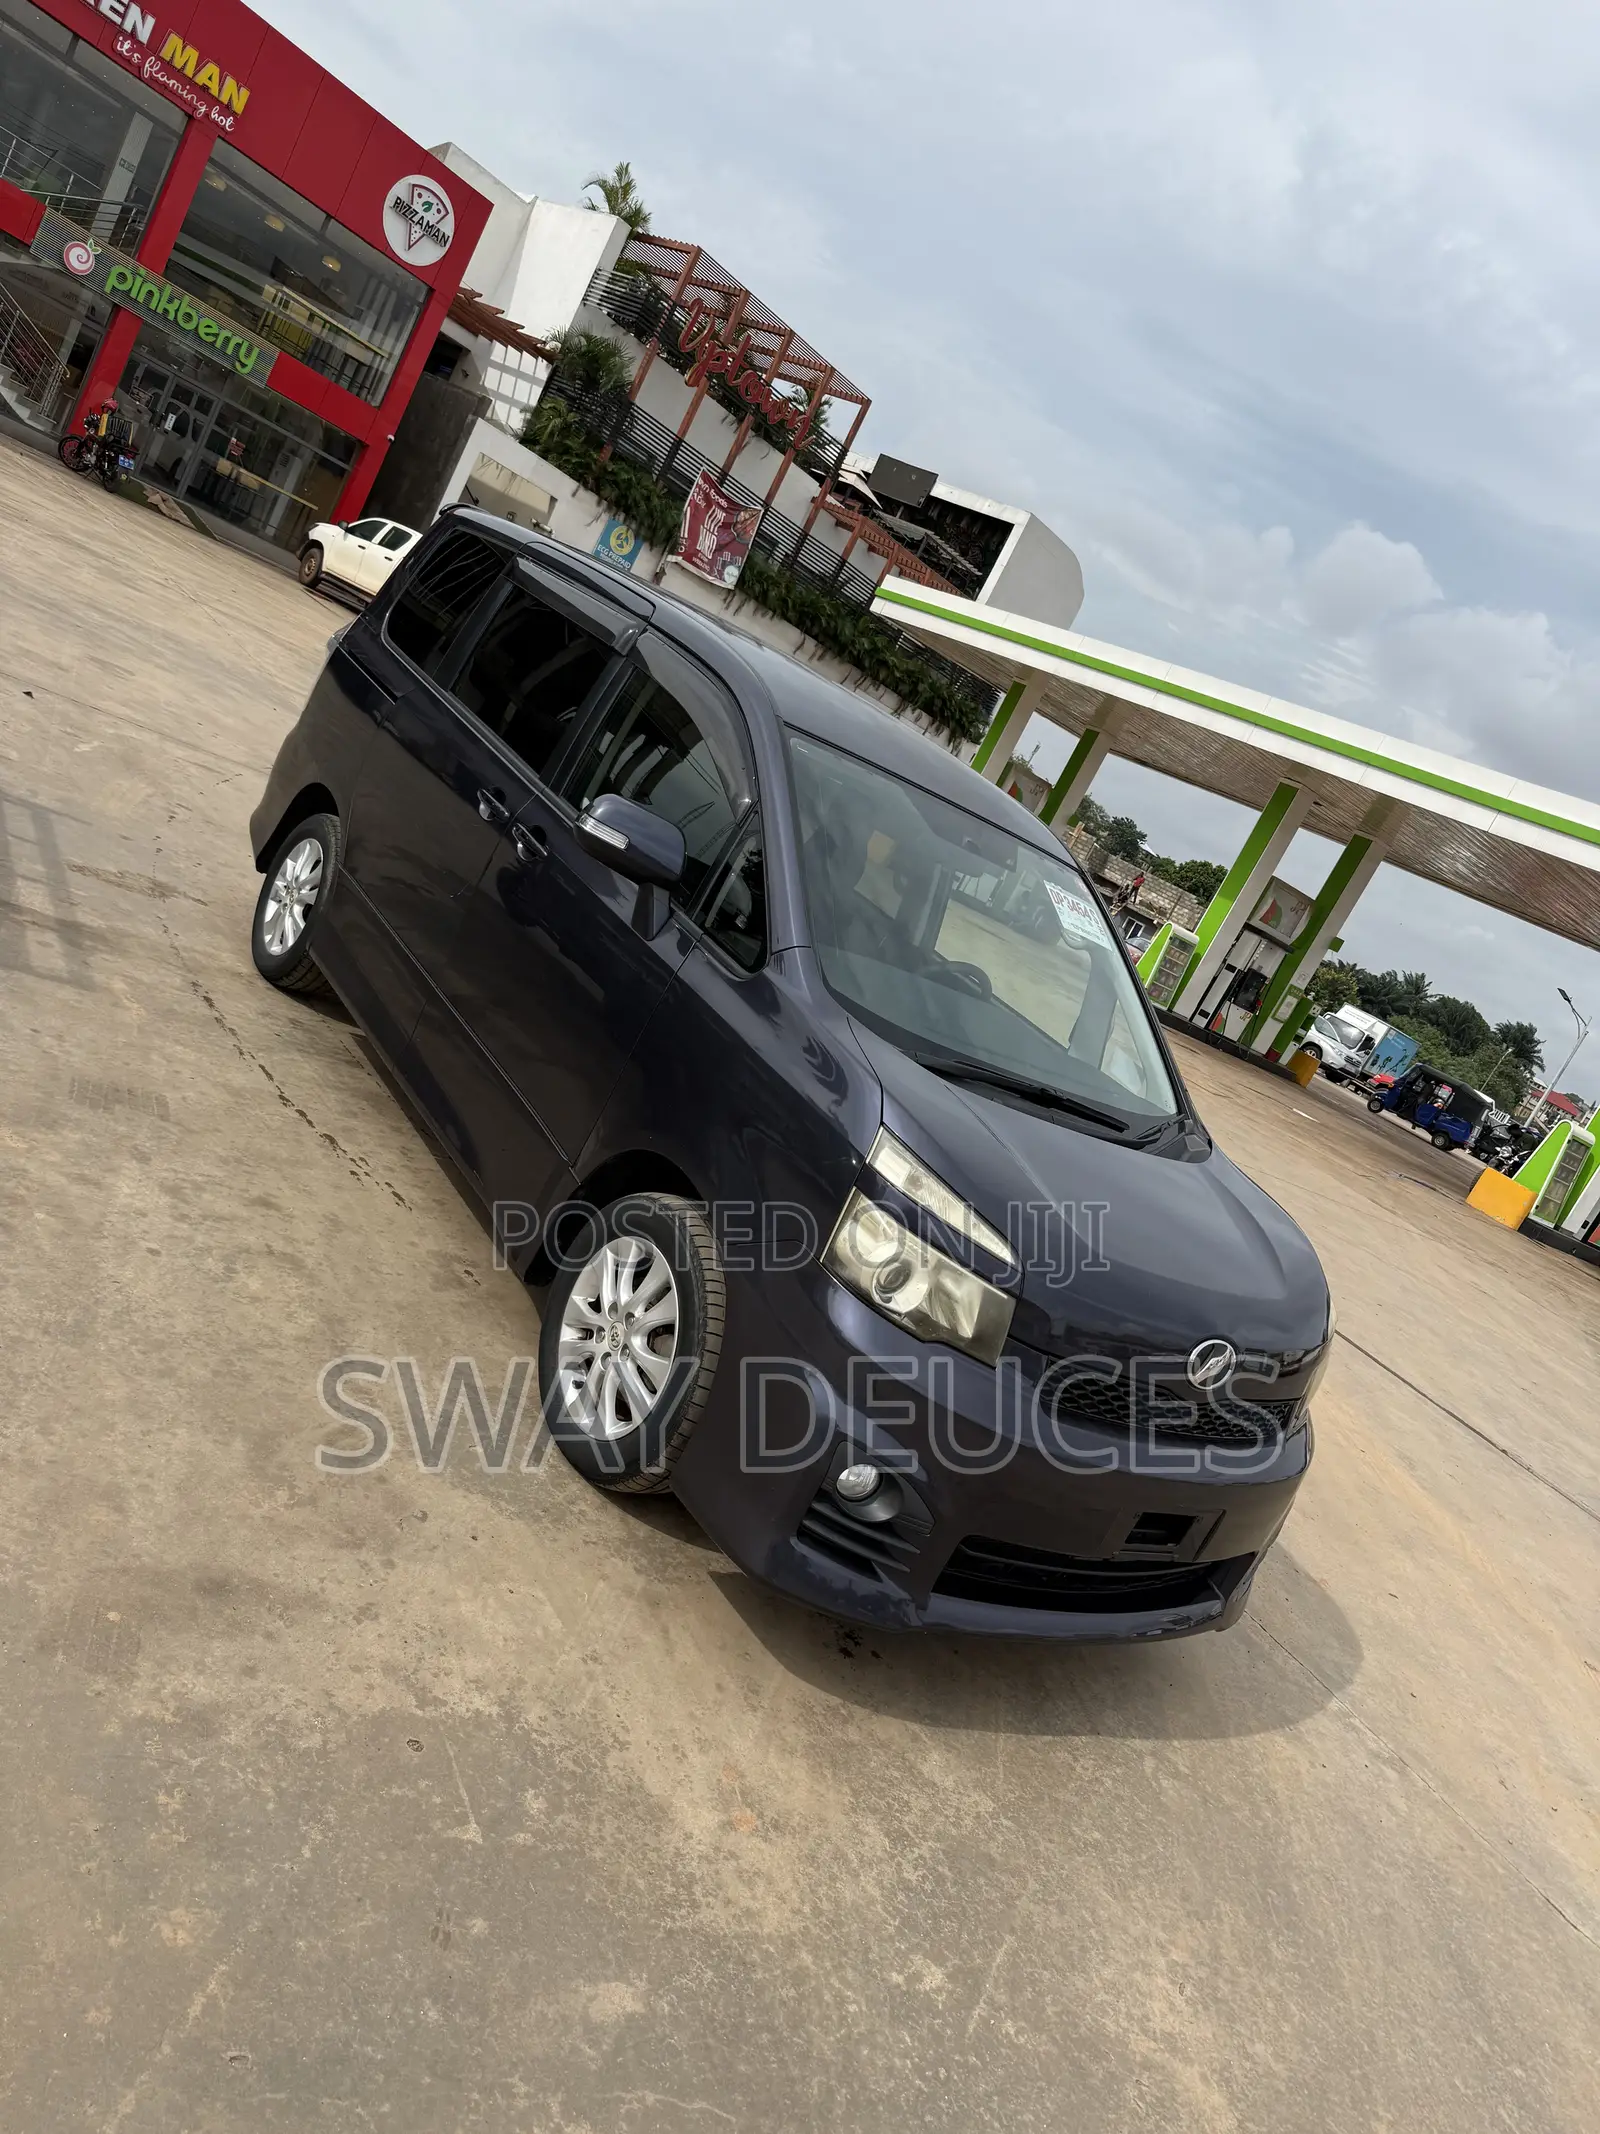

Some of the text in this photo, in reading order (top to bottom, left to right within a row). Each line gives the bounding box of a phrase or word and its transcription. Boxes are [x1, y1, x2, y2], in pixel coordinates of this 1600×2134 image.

[79, 0, 250, 115] EN MAN
[116, 36, 235, 132] it's flaming hot
[391, 196, 450, 248] PIZZAMAN
[103, 264, 260, 375] pinkberry
[678, 297, 817, 450] Uptown
[597, 544, 609, 556] ECG
[608, 551, 631, 569] PREPAID
